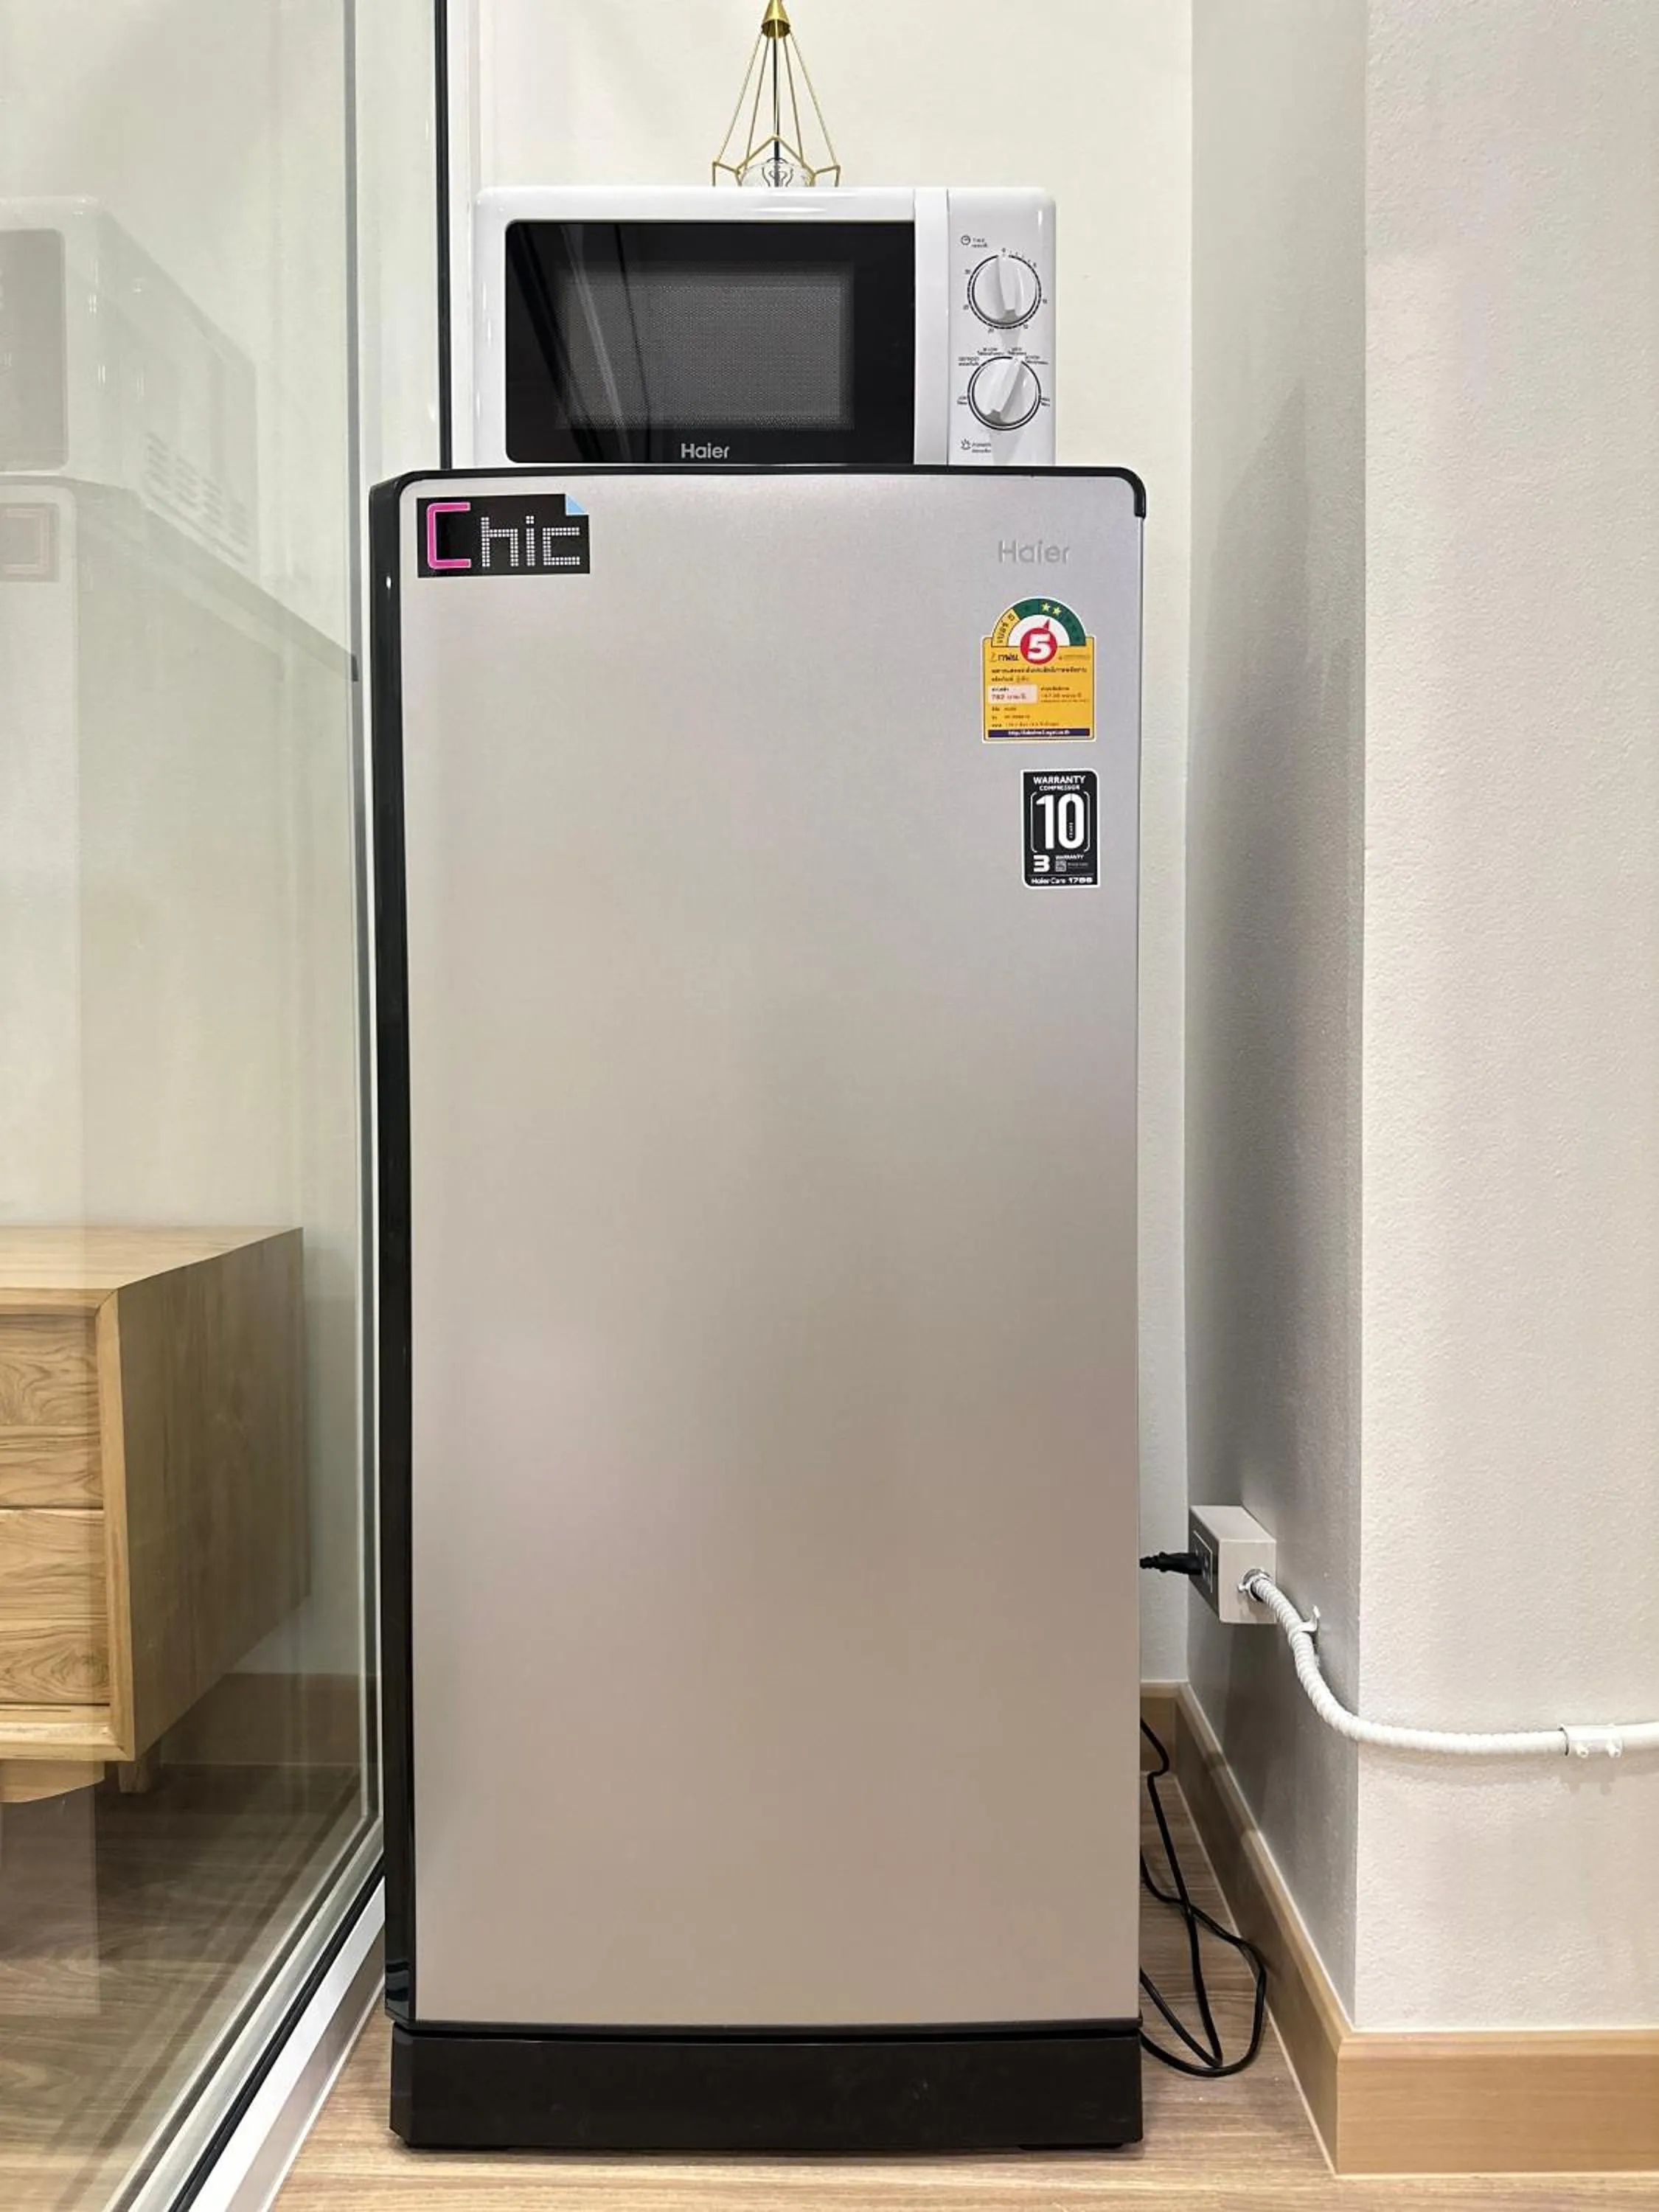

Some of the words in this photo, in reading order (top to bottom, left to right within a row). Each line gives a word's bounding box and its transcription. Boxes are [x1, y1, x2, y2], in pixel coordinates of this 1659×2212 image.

[681, 442, 730, 459] Haier
[426, 502, 580, 569] Chic
[998, 539, 1071, 563] Haier
[1027, 632, 1052, 660] 5
[1033, 775, 1085, 785] WARRANTY
[1036, 793, 1085, 849] 10
[1033, 855, 1050, 872] 3
